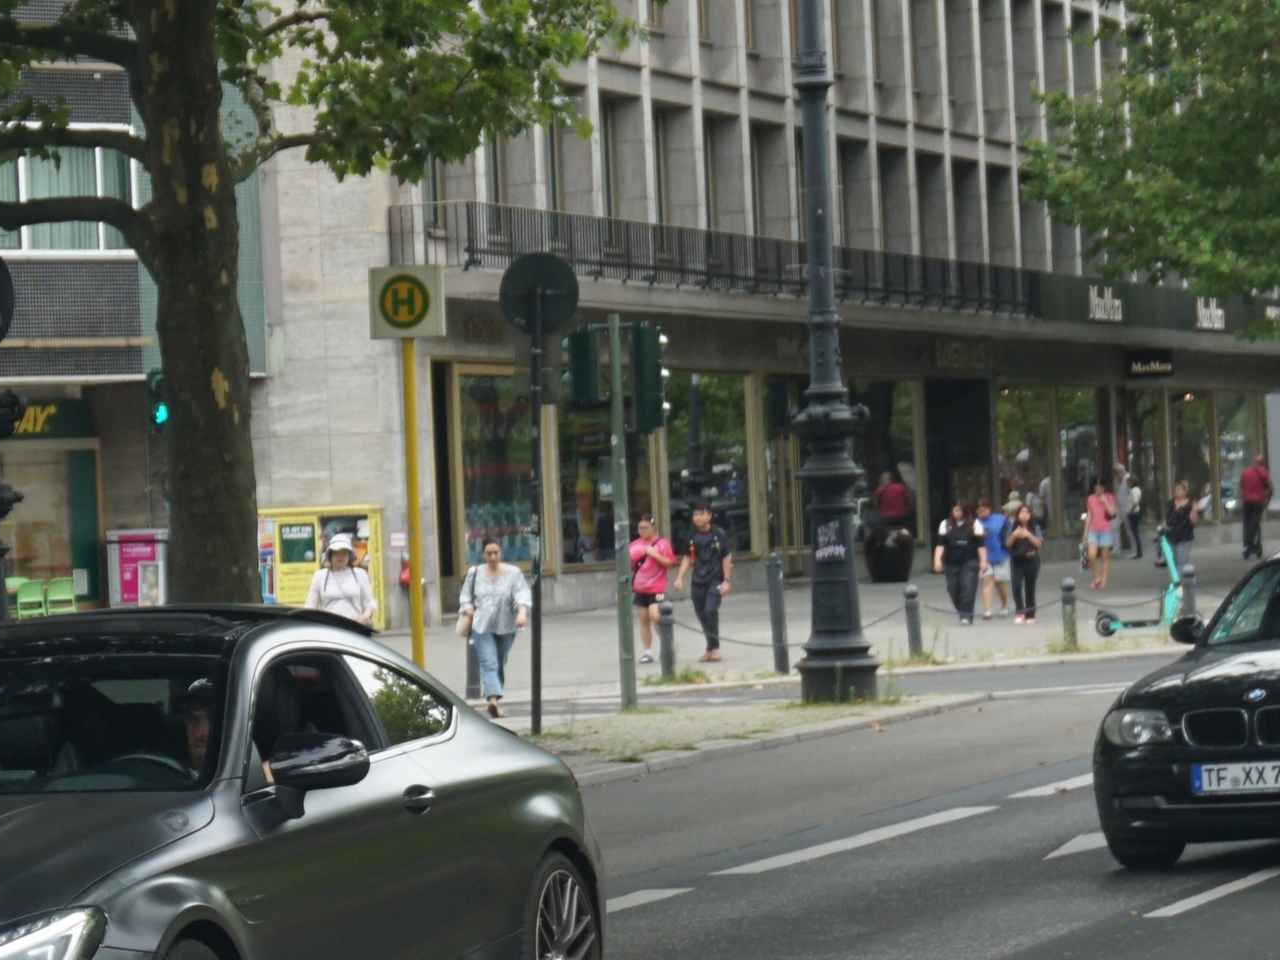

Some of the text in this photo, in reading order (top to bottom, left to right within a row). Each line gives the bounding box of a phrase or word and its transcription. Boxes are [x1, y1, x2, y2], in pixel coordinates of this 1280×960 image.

[391, 286, 415, 316] H
[1131, 361, 1172, 374] MaxMara
[1204, 767, 1228, 787] TF
[1243, 765, 1268, 786] XX
